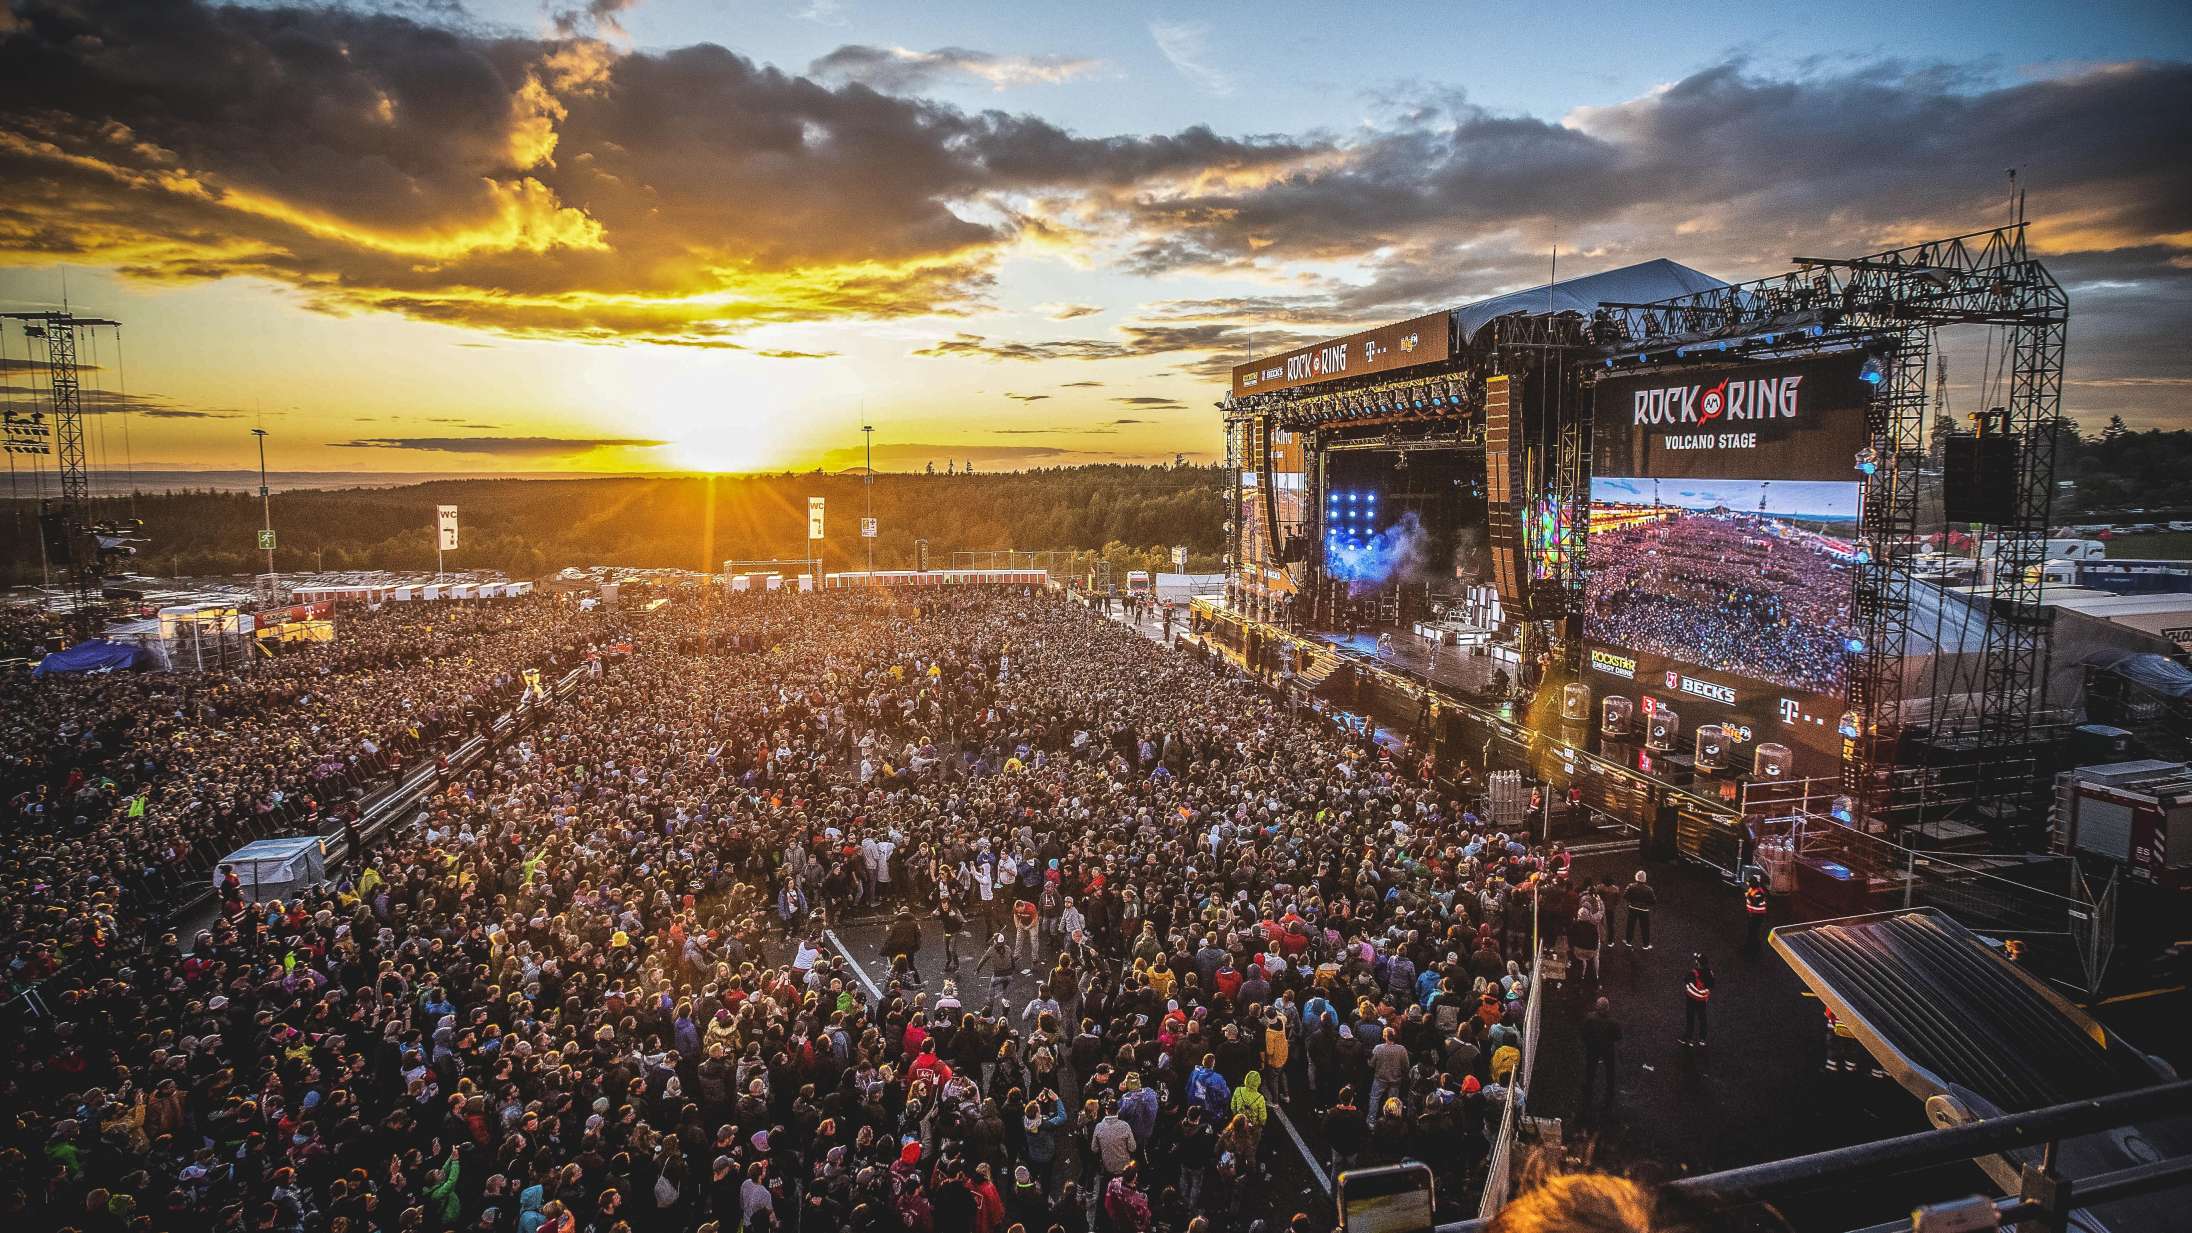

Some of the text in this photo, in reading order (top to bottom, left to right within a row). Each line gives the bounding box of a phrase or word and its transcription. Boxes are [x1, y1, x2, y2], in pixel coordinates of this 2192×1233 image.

[1288, 352, 1312, 382] ROCK
[1322, 344, 1347, 374] RING
[1634, 385, 1700, 425] ROCK
[1727, 376, 1802, 420] RING
[1665, 433, 1756, 449] VOLCANO STAGE
[1592, 650, 1636, 672] ROCKSTAR
